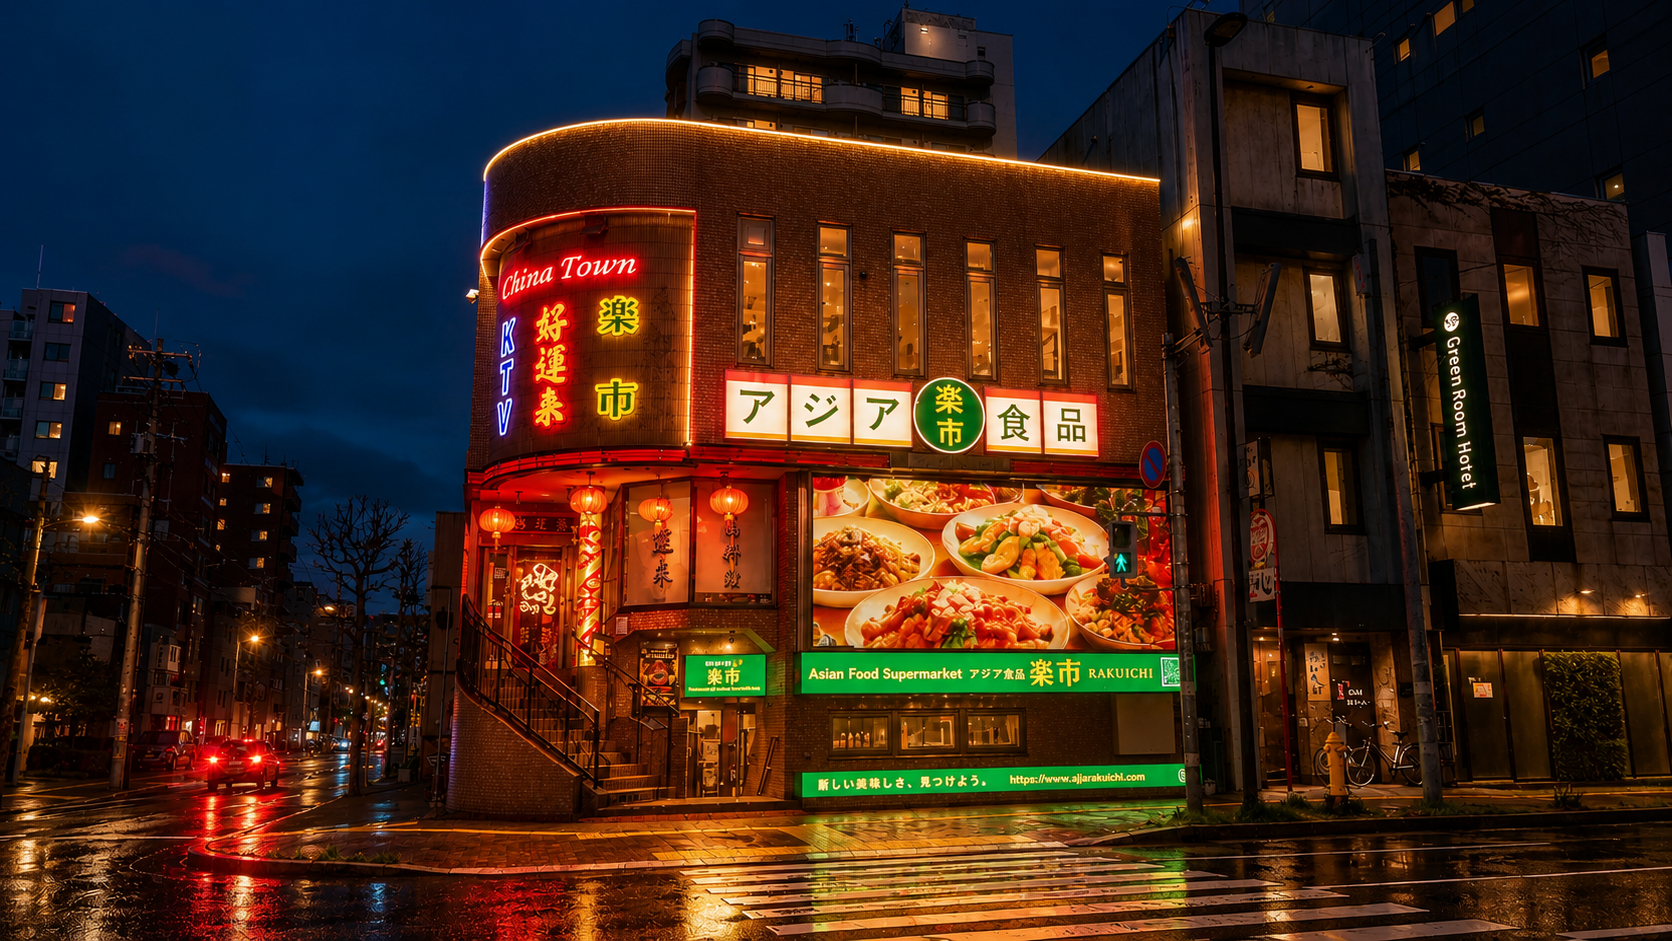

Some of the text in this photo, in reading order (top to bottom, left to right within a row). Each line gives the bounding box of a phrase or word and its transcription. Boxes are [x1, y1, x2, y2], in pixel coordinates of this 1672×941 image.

[502, 255, 636, 300] China Town
[497, 317, 517, 436] KTV
[534, 302, 569, 429] 好運来
[595, 295, 640, 421] 楽市
[1446, 336, 1461, 387] Green
[739, 388, 1086, 443] アジア 食品
[935, 384, 964, 447] 楽市
[1452, 388, 1467, 438] Room
[707, 667, 740, 686] 楽市
[808, 667, 844, 680] Asian
[848, 667, 879, 680] Food
[882, 667, 963, 682] Supermarket
[1029, 658, 1081, 687] 楽市
[1088, 667, 1153, 679] RAKUICHI
